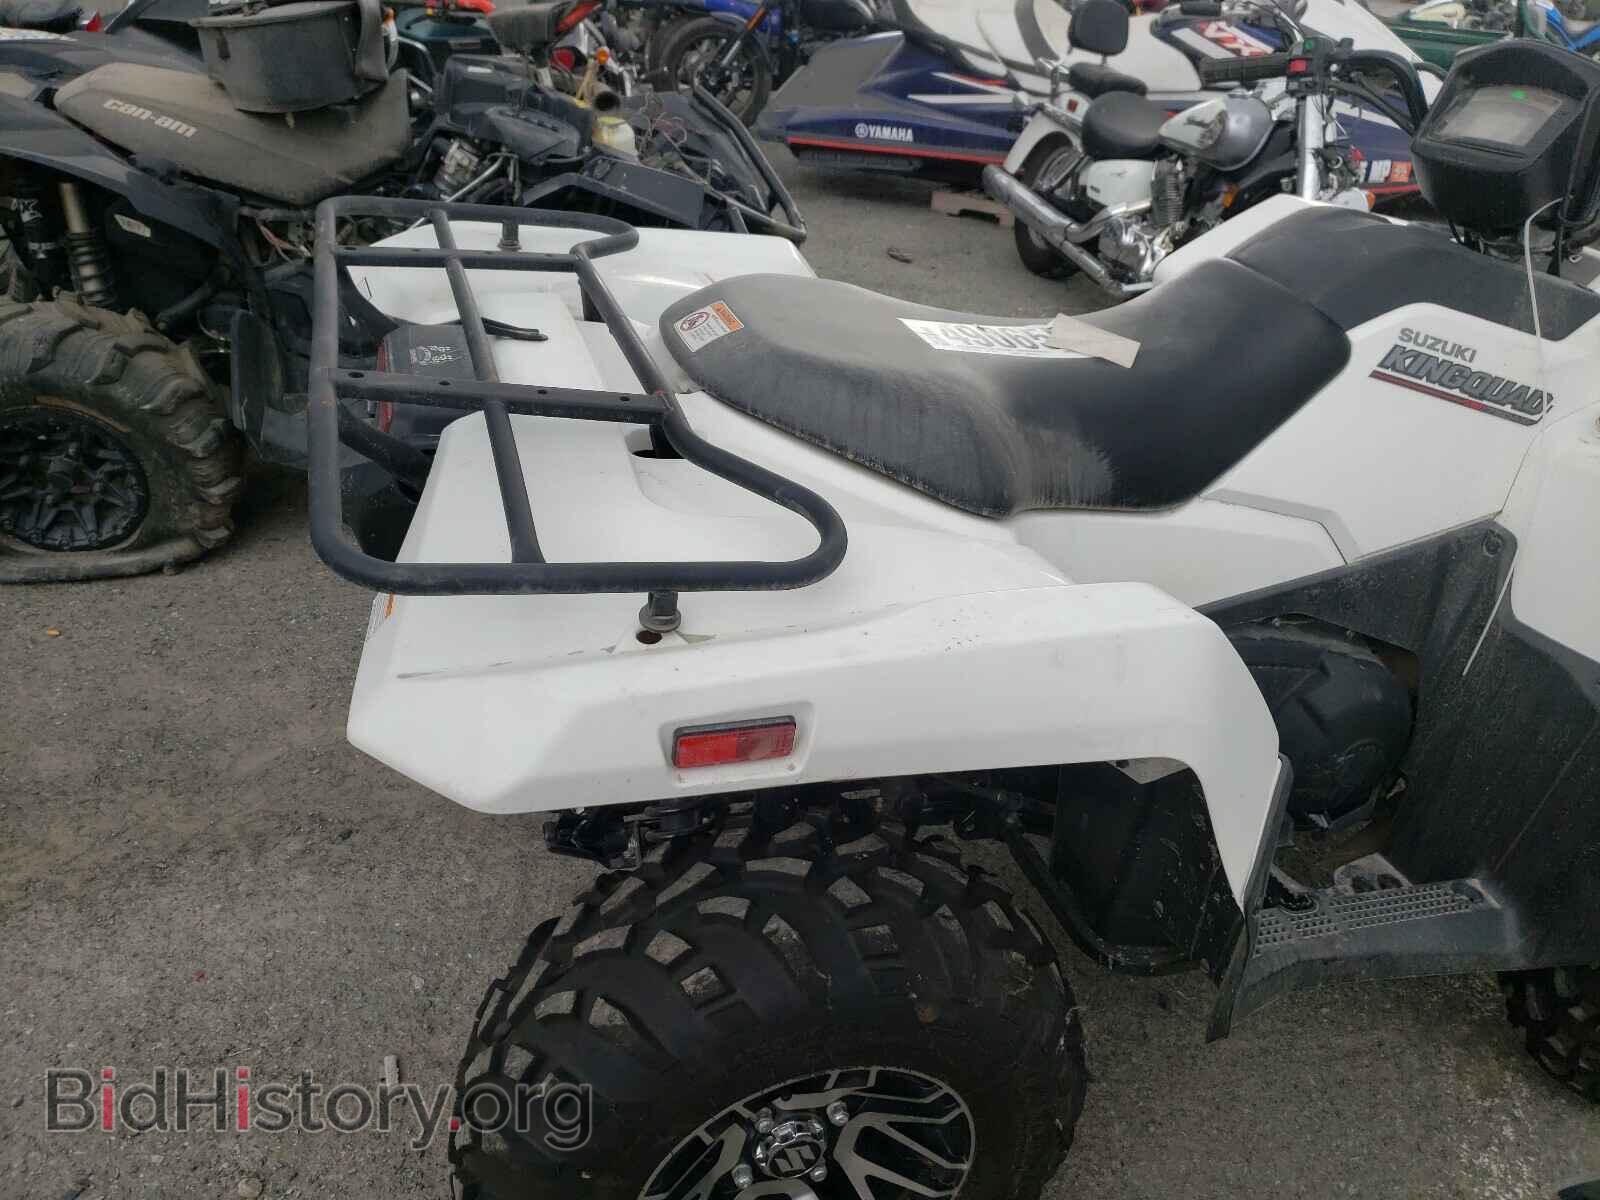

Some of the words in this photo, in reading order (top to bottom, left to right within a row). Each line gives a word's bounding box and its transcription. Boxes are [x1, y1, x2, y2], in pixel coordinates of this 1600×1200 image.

[103, 99, 197, 138] can-am
[869, 124, 914, 142] YAMAHA
[1398, 327, 1478, 363] SUZUKI
[1377, 344, 1553, 416] KINGQUAD
